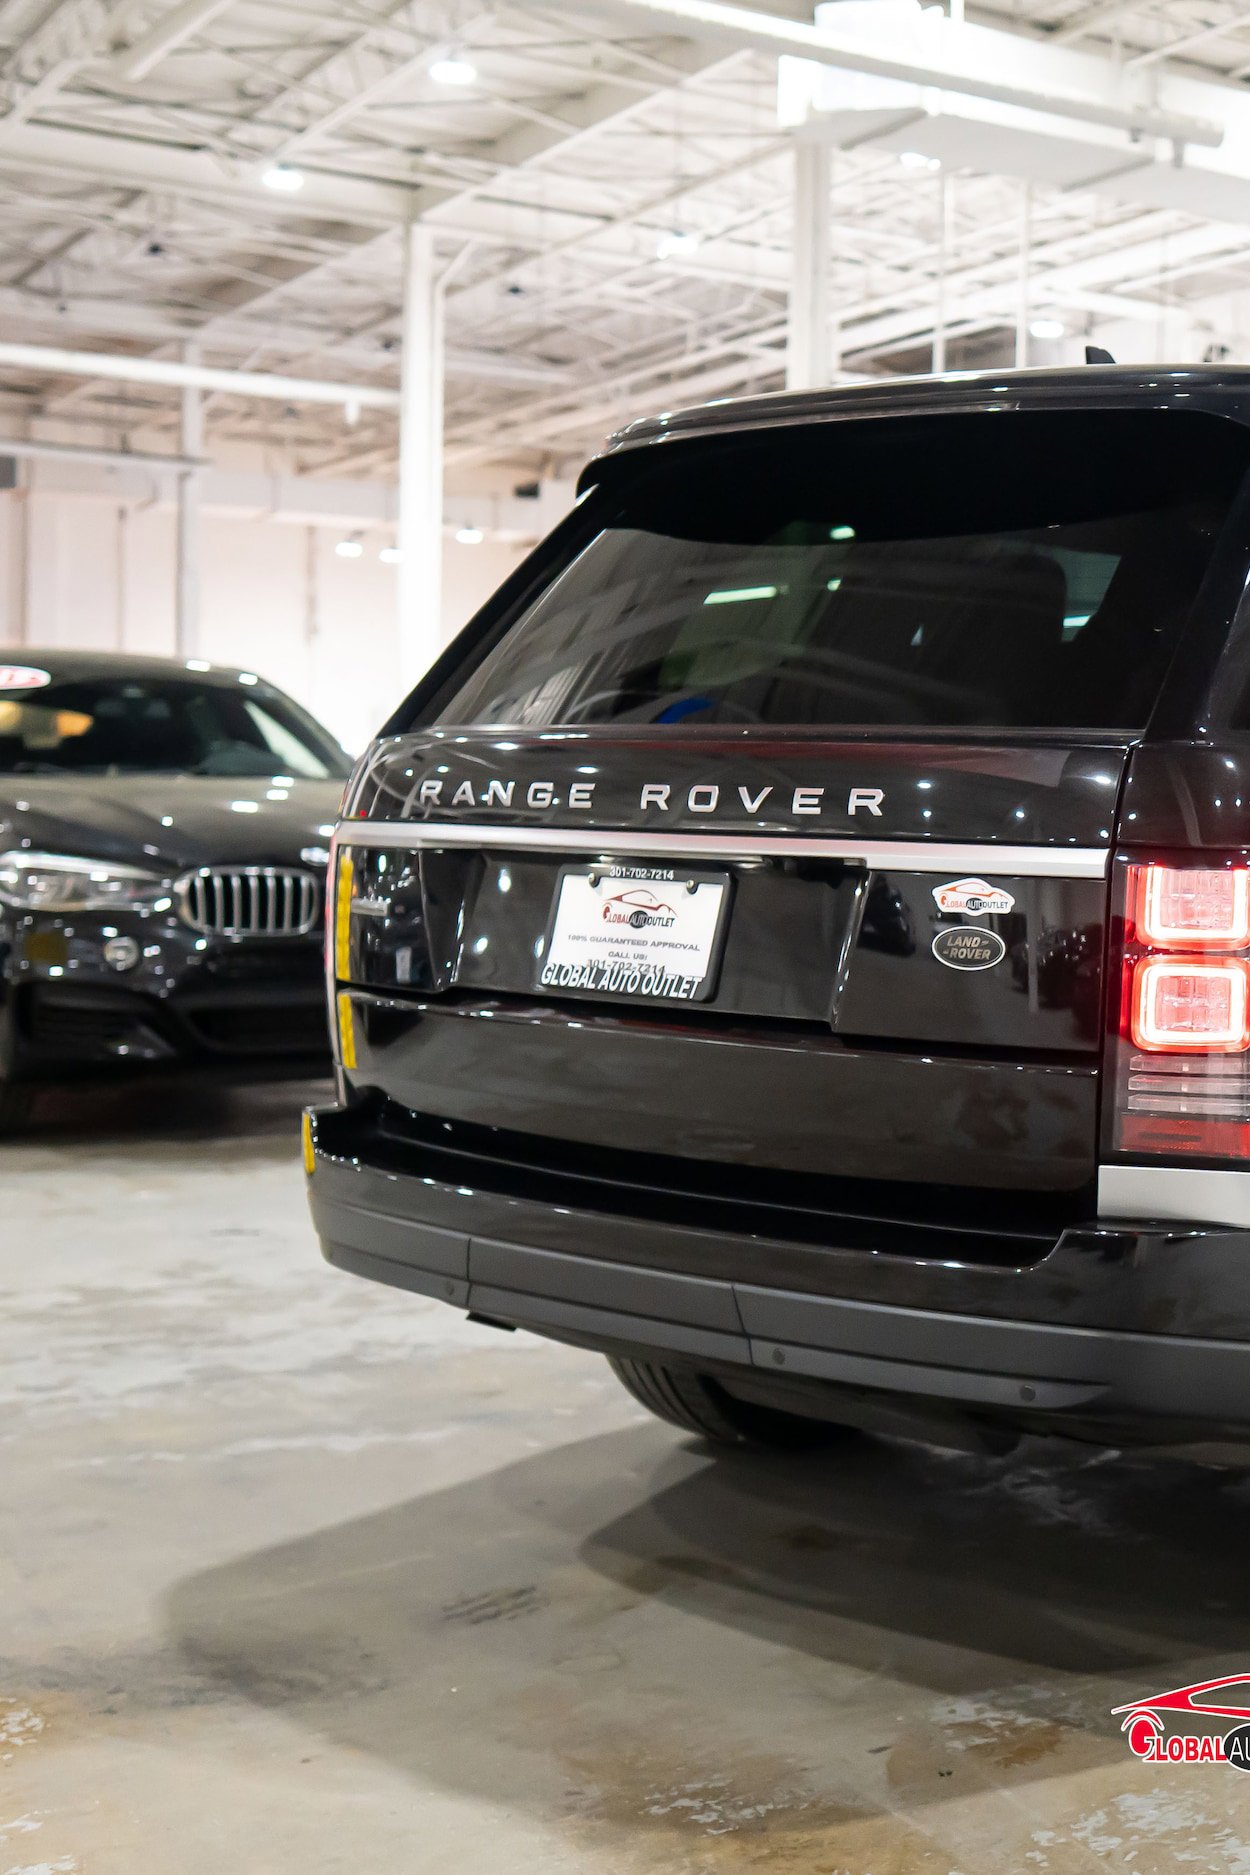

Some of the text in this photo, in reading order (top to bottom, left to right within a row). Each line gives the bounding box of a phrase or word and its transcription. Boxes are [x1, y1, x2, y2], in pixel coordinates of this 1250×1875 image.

[418, 779, 886, 817] RANGE ROVER
[609, 865, 675, 881] 301-702-7214
[589, 935, 649, 948] GUARANTEED
[650, 939, 701, 952] APPROVAL
[608, 950, 632, 960] CALL
[540, 962, 703, 1000] GLOBAL AUTO OUTLET
